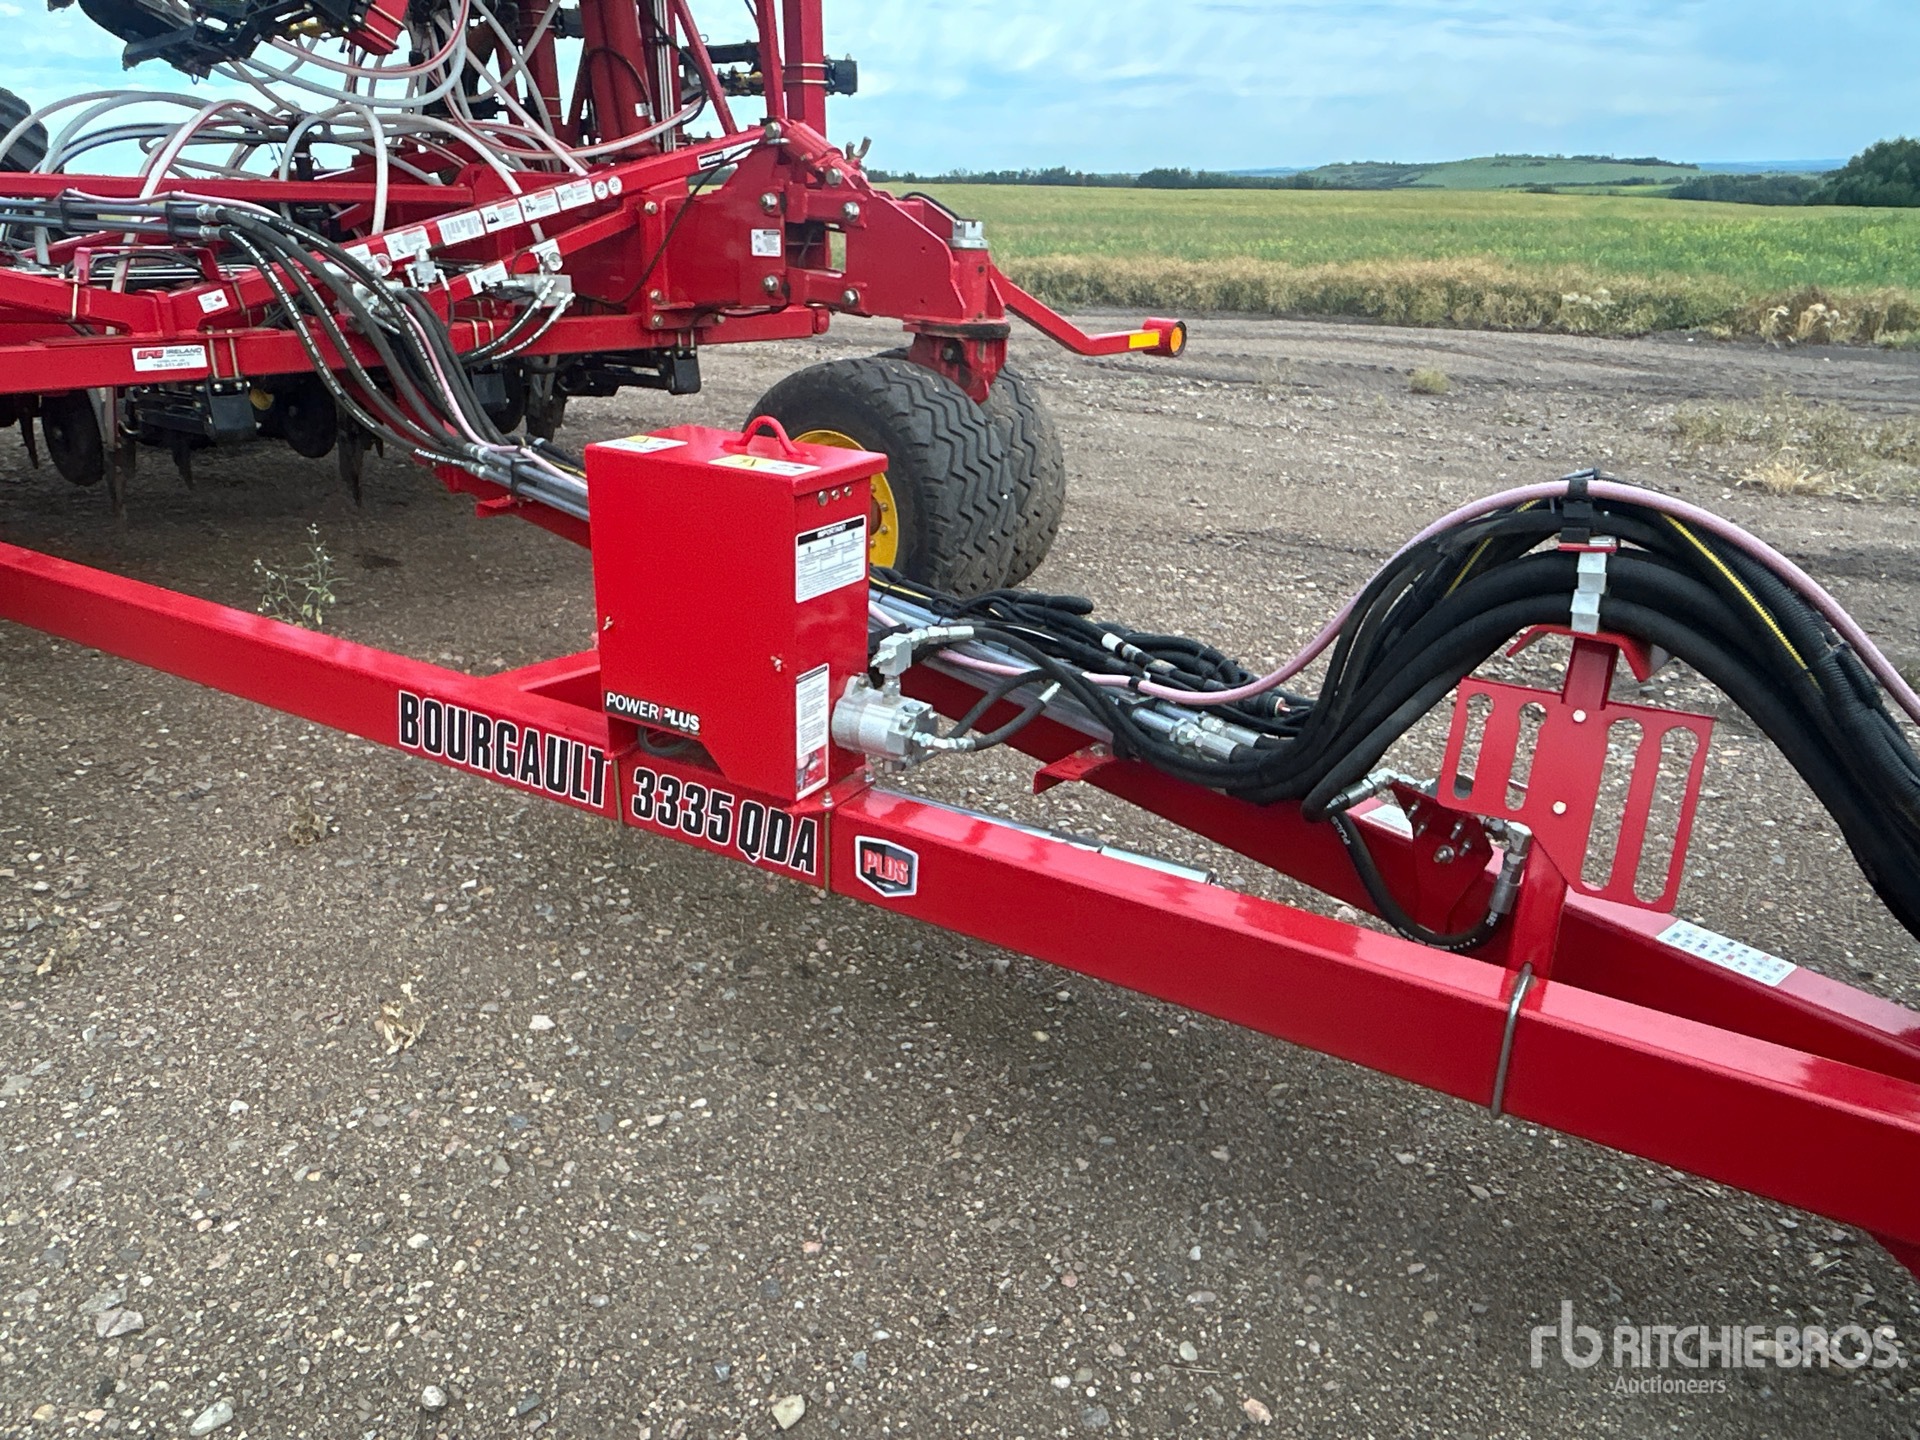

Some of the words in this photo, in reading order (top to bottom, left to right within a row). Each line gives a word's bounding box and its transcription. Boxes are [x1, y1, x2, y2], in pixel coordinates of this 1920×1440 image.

[165, 347, 203, 355] IRELAND
[606, 692, 660, 720] POWER
[663, 707, 700, 731] PLUS
[398, 689, 611, 809] BOURGAULT
[632, 766, 735, 846] 3335
[736, 799, 818, 876] QDA
